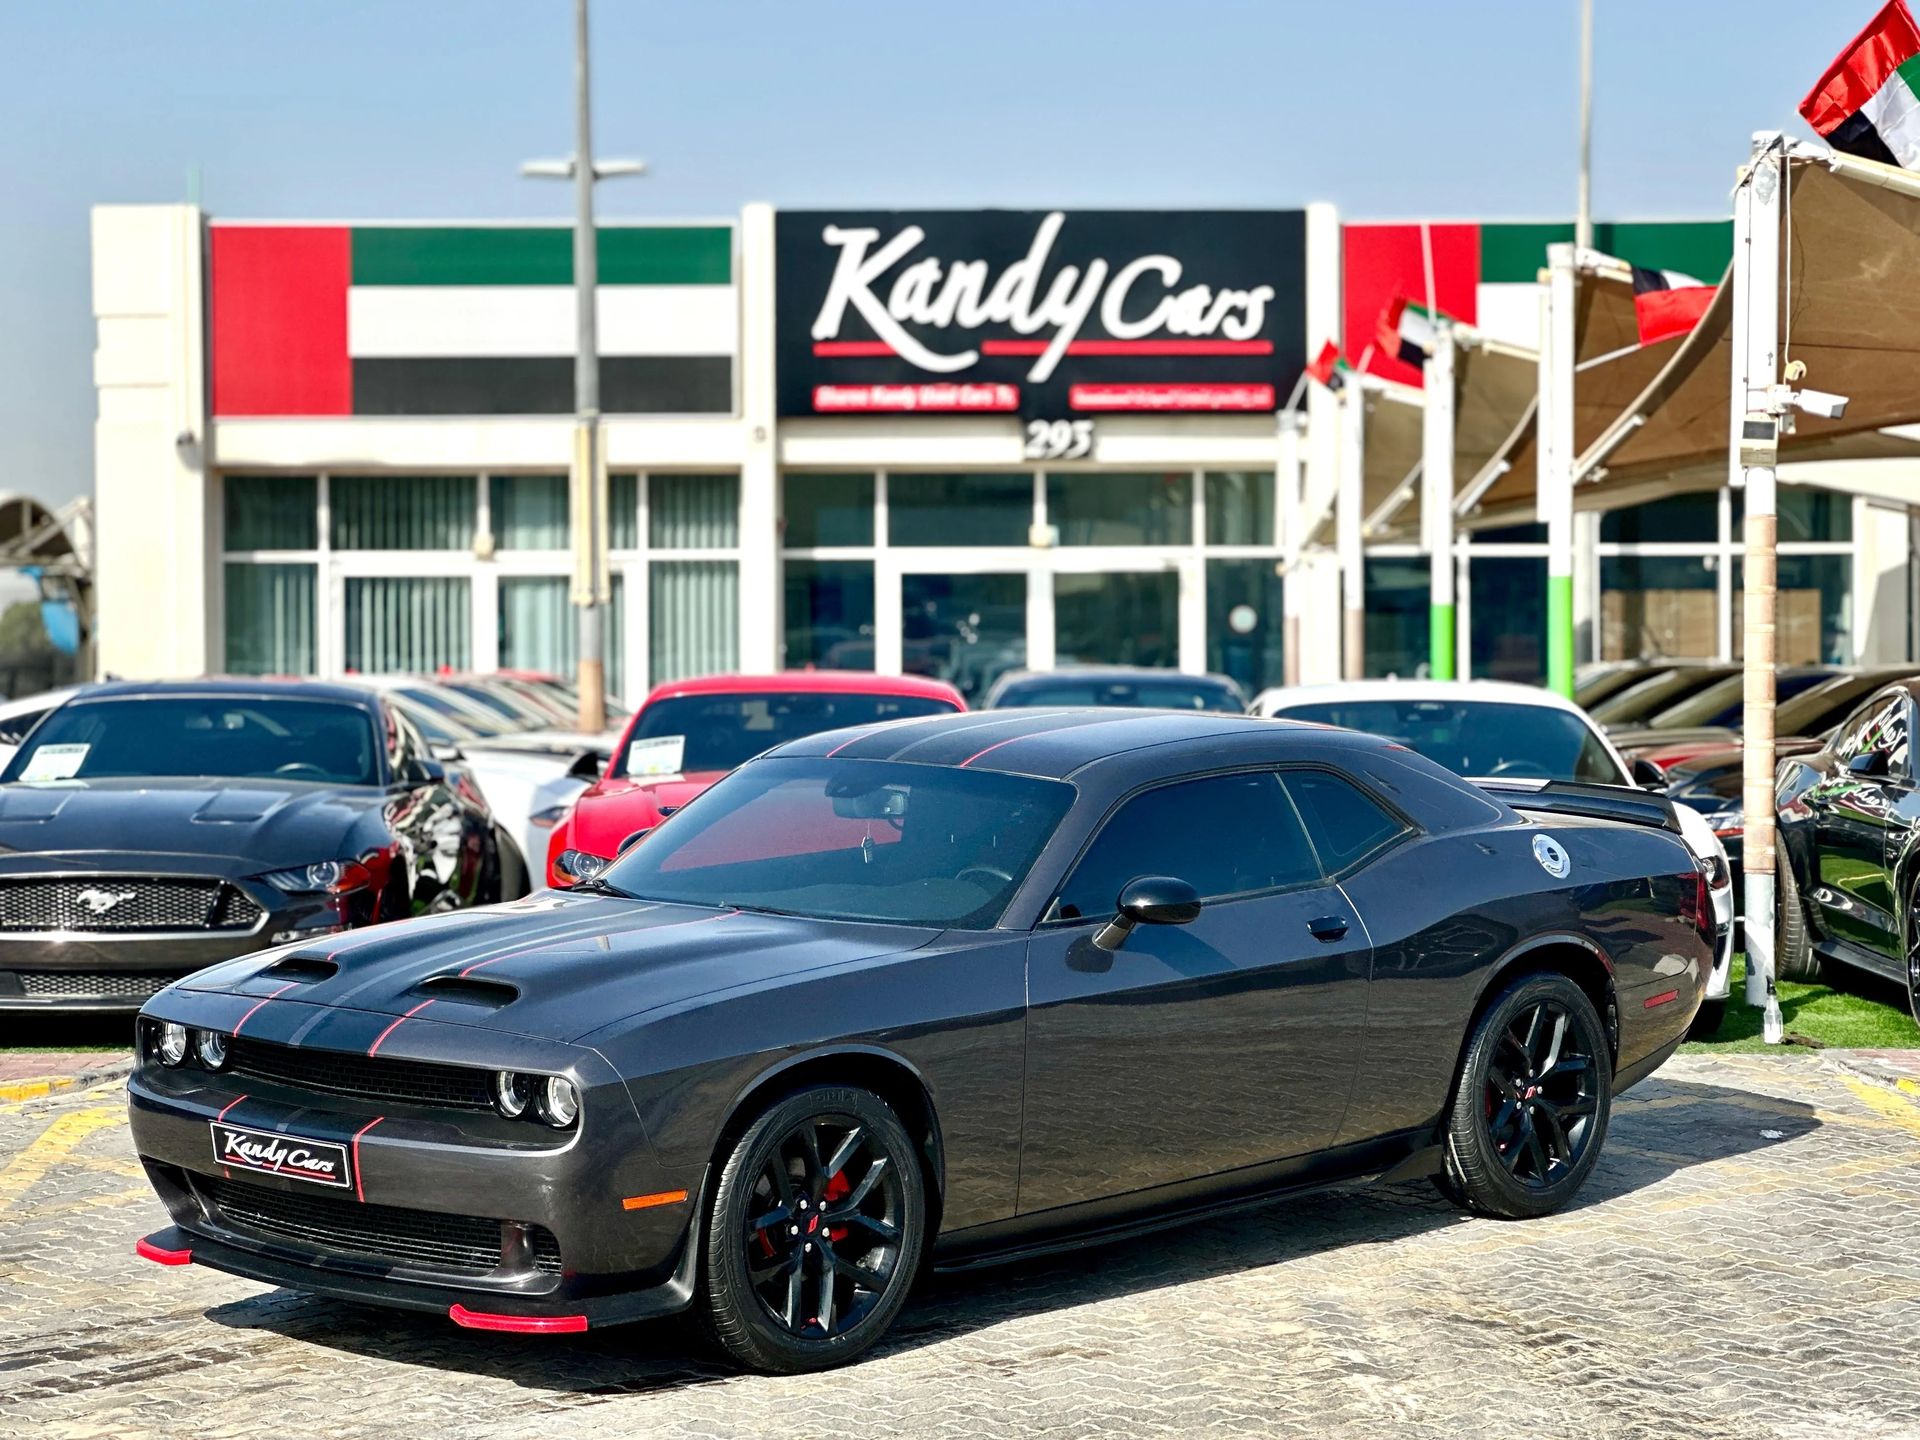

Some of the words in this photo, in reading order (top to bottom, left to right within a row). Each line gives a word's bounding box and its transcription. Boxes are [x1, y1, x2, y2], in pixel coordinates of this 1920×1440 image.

[811, 212, 1108, 382] Kandy
[1102, 255, 1274, 340] Cars
[224, 1132, 287, 1171] Kandy
[287, 1150, 334, 1172] Cars
